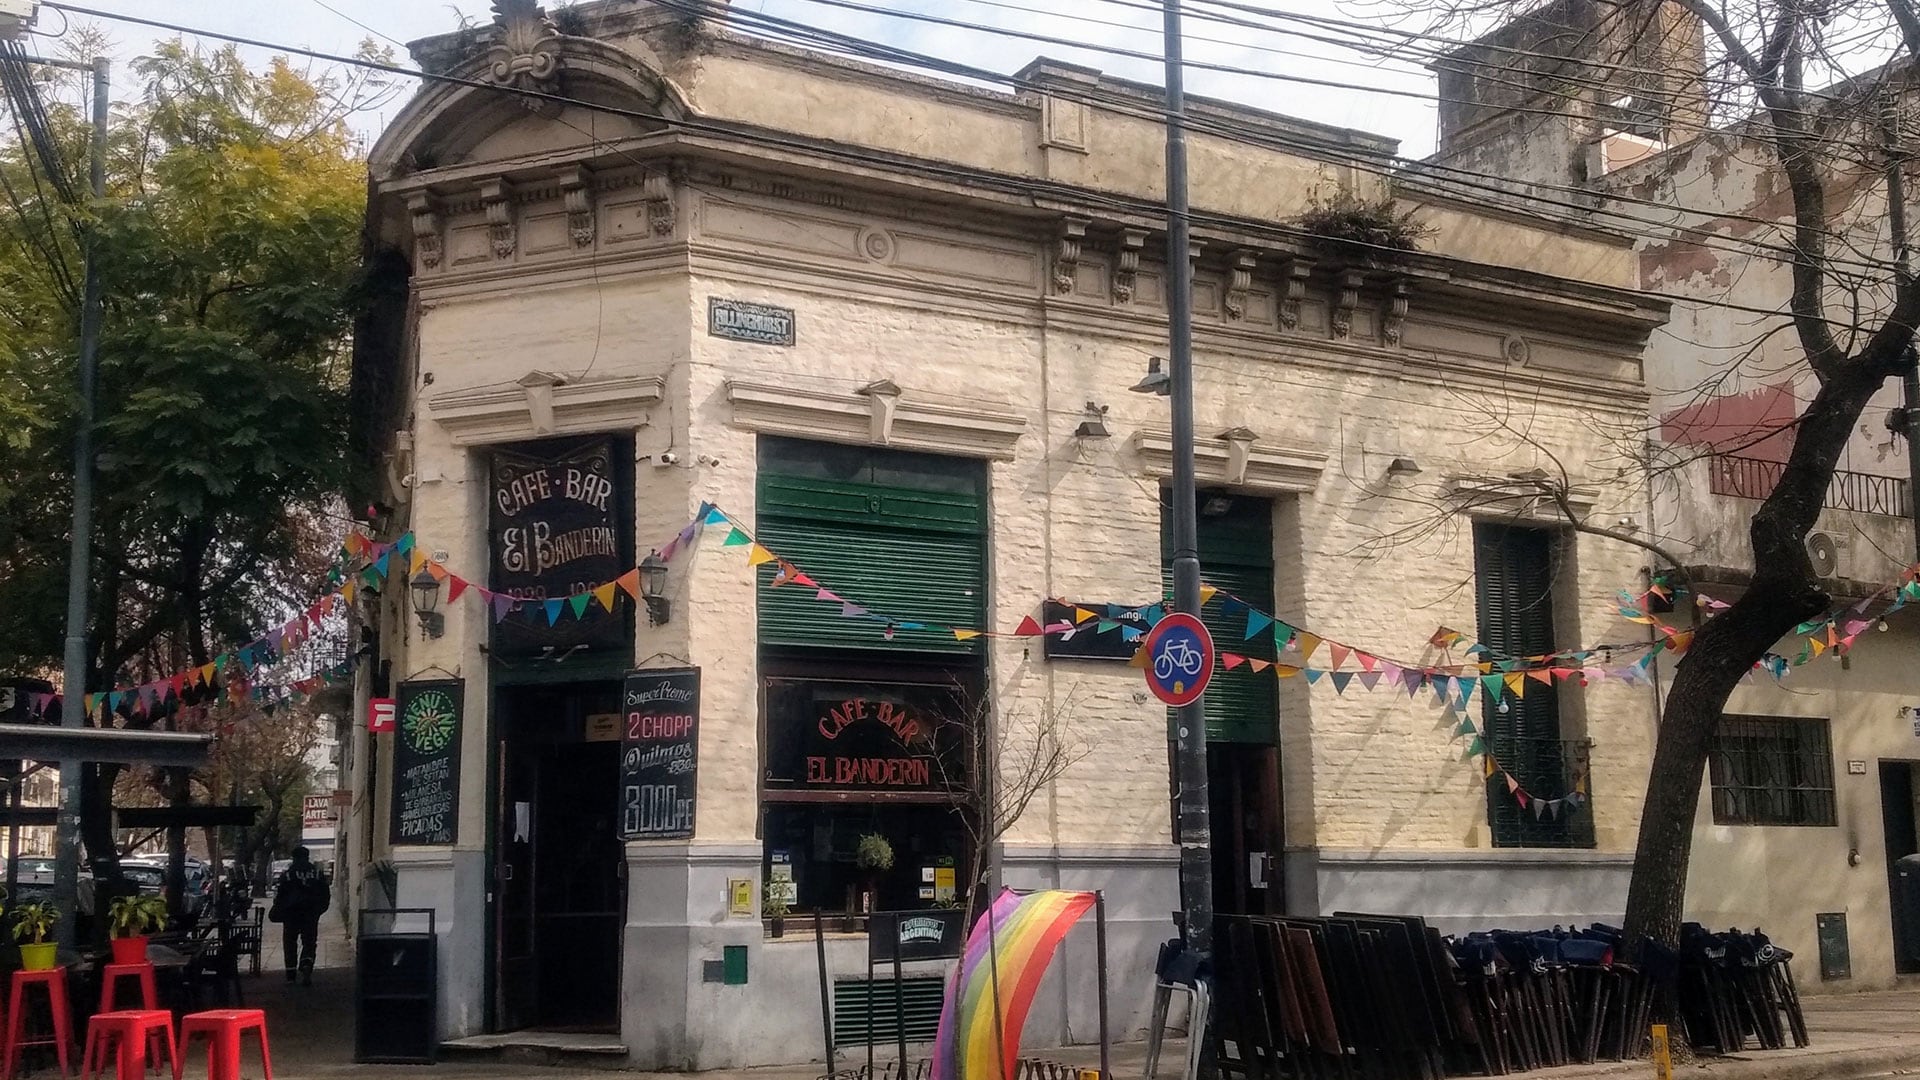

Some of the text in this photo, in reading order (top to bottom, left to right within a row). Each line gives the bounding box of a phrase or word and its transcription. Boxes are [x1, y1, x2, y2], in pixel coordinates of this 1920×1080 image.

[497, 468, 612, 517] CAFE BAR
[658, 680, 694, 701] Promo
[405, 694, 441, 730] MENU
[818, 697, 919, 748] CAFE BAR
[629, 712, 640, 739] 2
[642, 715, 693, 738] CHOPP
[406, 757, 449, 780] MATAMBRE
[806, 756, 929, 786] EL BANDERIN
[404, 781, 442, 801] MILANESA
[402, 814, 443, 837] PICADAS
[900, 927, 942, 941] ARGENTINOS
